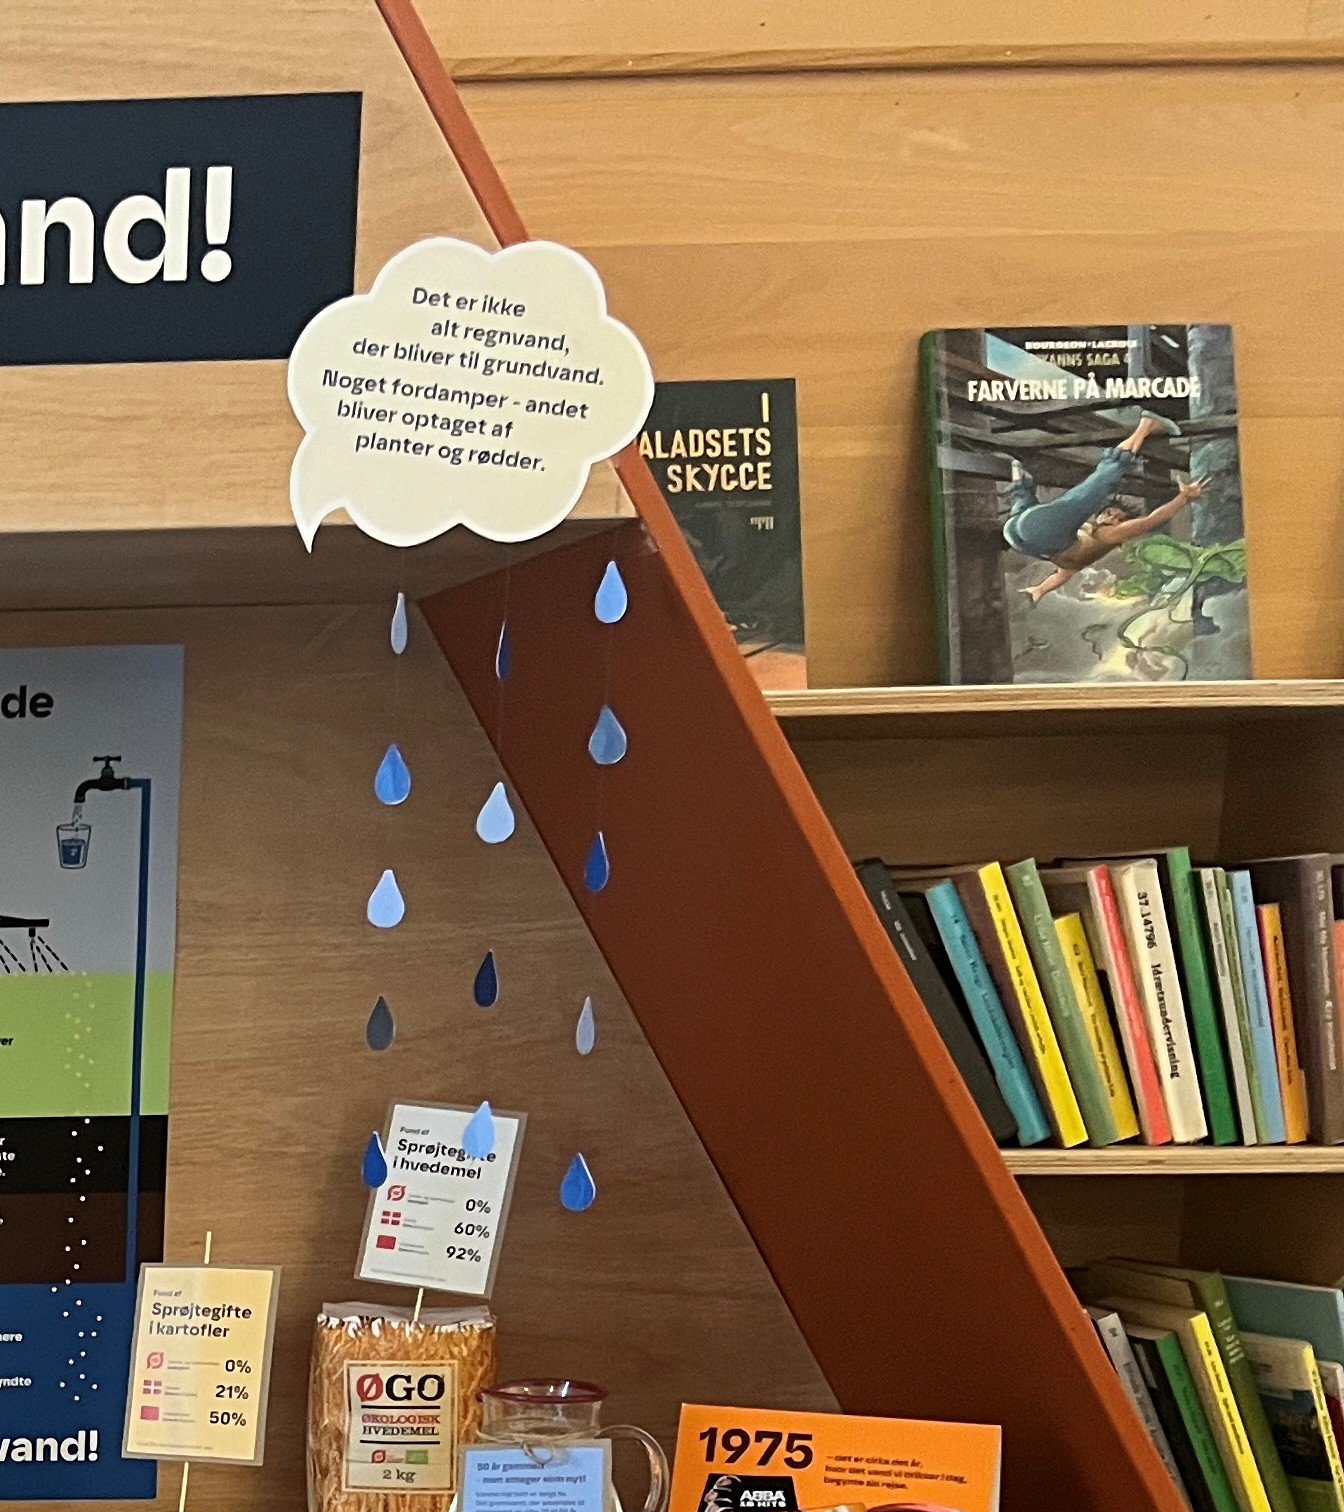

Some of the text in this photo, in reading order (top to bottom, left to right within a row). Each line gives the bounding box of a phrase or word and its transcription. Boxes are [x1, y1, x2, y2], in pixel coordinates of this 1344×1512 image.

[412, 286, 526, 318] Det er ikke
[430, 319, 570, 362] alt regnvand,
[352, 337, 604, 386] der bliver til grundvand.
[322, 368, 387, 396] Noget
[391, 378, 509, 410] fordamper
[525, 399, 589, 419] andet
[967, 371, 1202, 403] FARVERNE PÅ MARCADE
[337, 399, 514, 439] bliver optaget af
[355, 432, 545, 472] planter og rødder.
[638, 427, 771, 459] ALADSETS
[396, 1136, 498, 1166] Sprøjtege
[402, 1157, 482, 1180] hvedemel
[465, 1198, 491, 1214] 0%
[453, 1221, 490, 1239] 60%
[446, 1245, 482, 1263] 92%
[151, 1302, 253, 1322] Sprøjtegifte
[156, 1321, 231, 1338] kartofler
[224, 1358, 252, 1374] 0%
[215, 1384, 249, 1400] 21%
[356, 1373, 446, 1403] ØGO
[209, 1410, 247, 1427] 50%
[360, 1412, 442, 1425] ØKOLOGISK
[362, 1425, 440, 1437] HVEDEMEL
[699, 1426, 813, 1470] 1975
[382, 1468, 417, 1484] 2 kg
[739, 1489, 786, 1504] ABBA
